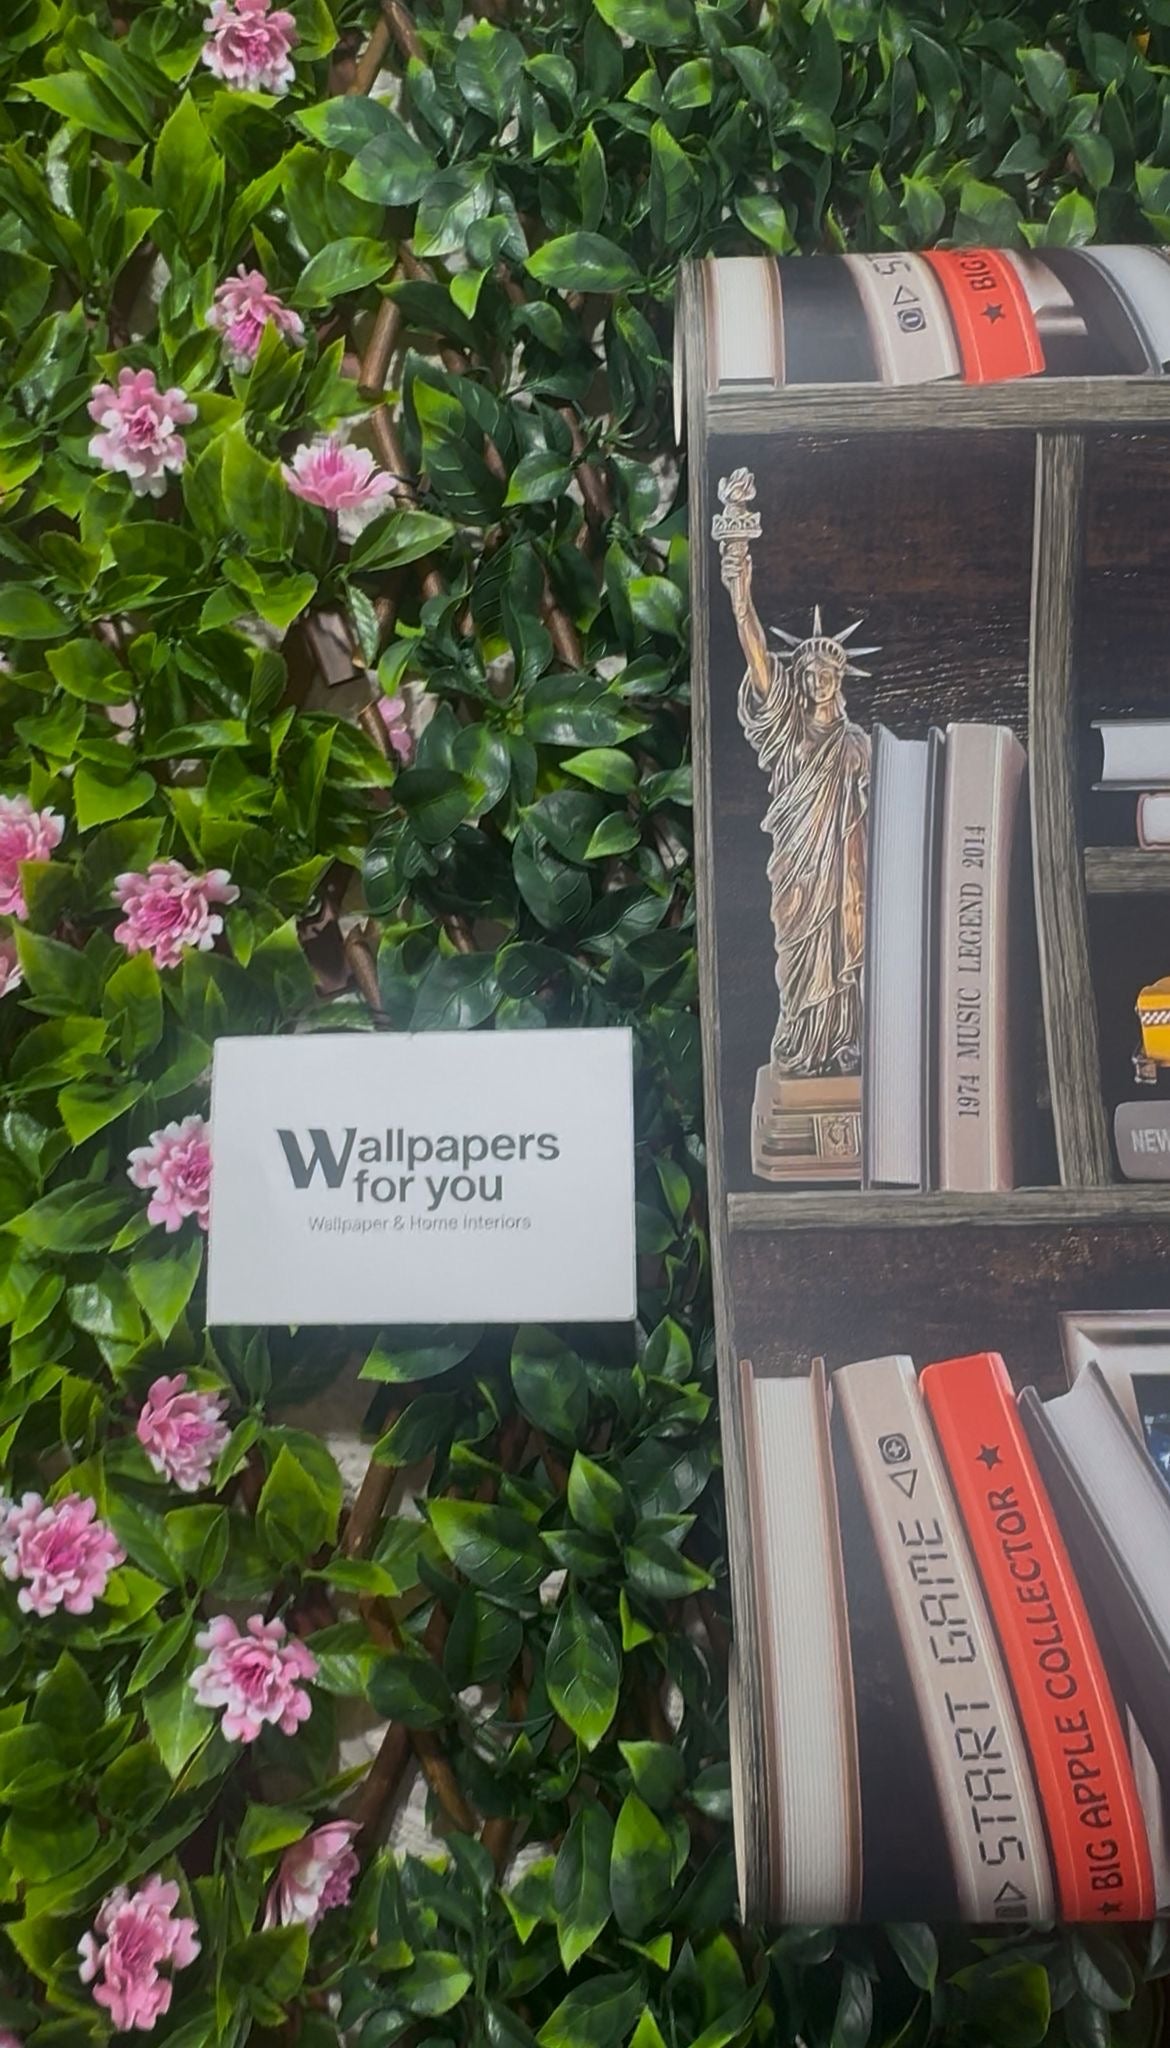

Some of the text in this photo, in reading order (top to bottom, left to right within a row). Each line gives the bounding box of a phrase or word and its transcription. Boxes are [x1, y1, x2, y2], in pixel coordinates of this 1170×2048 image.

[956, 825, 986, 1118] 1974 MUSIC LEGEND 2014
[276, 1127, 560, 1189] Wallpapers
[308, 1215, 532, 1234] Wallpaper & Home Interiors
[353, 1169, 503, 1211] for you
[898, 1518, 1025, 1866] START GAME
[987, 1485, 1124, 1891] BIG APPLE COLLECTOR
